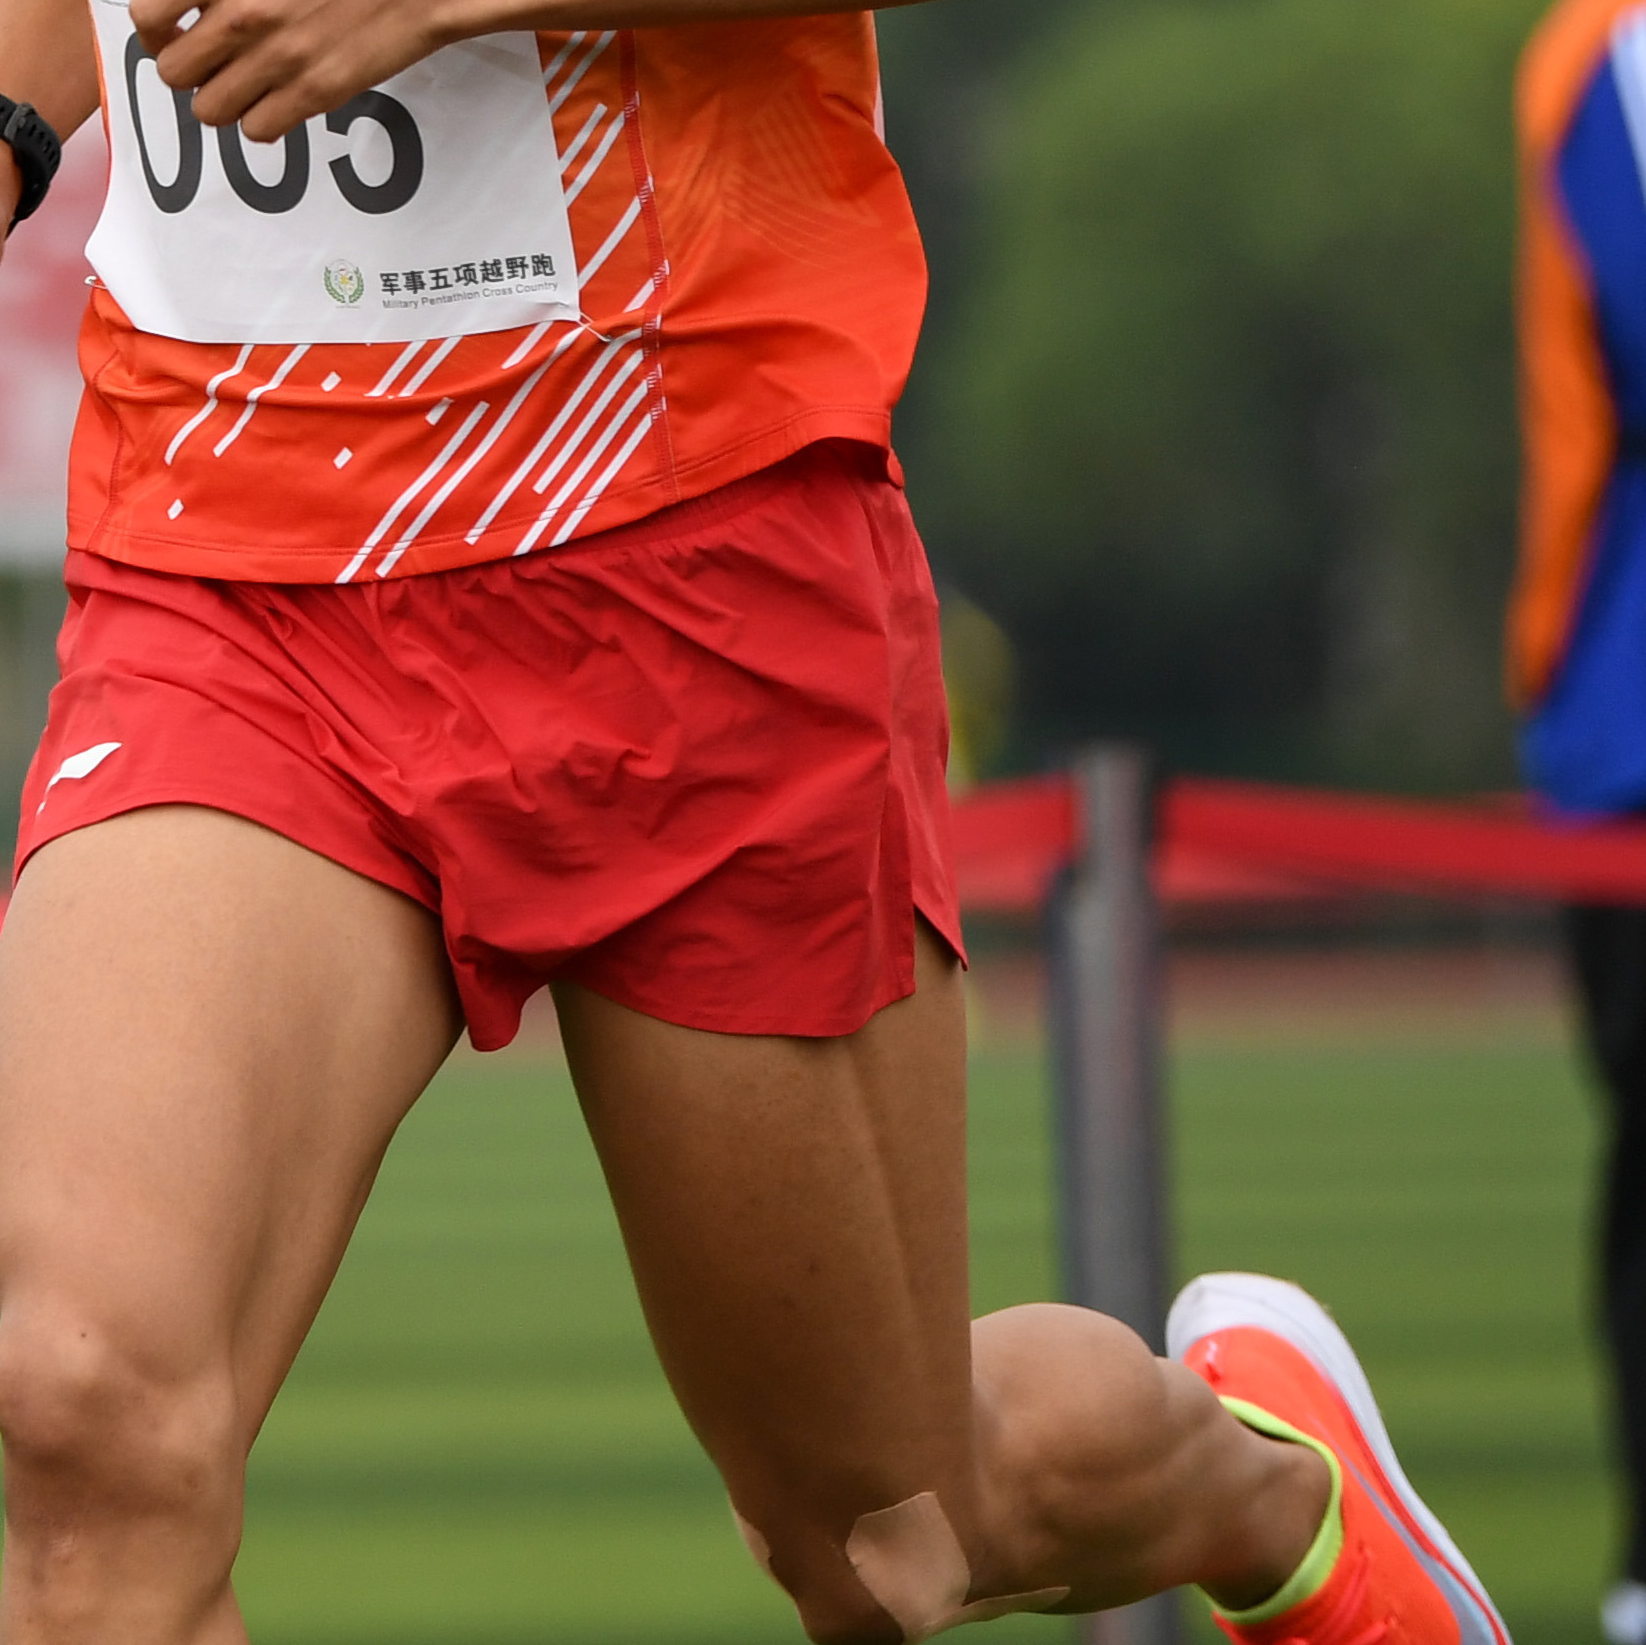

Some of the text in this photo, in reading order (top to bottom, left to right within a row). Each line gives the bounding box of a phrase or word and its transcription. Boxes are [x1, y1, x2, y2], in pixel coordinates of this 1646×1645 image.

[379, 253, 557, 296] 军事五项越野跑
[382, 280, 558, 310] Military Pentathlon Cross Country
